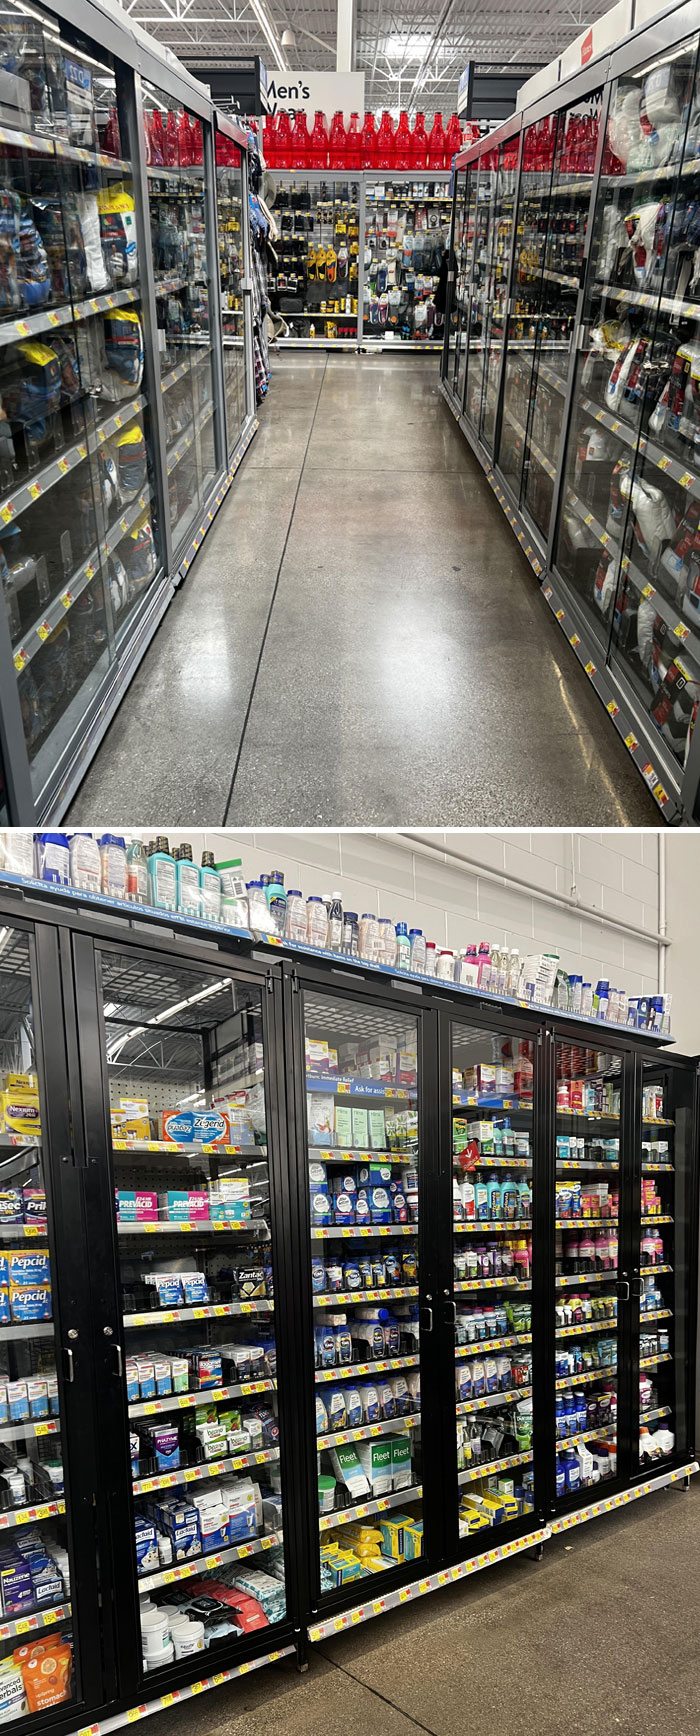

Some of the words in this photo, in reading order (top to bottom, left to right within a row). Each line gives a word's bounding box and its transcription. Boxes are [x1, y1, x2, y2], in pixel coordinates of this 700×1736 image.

[267, 80, 310, 99] Men's
[0, 1201, 20, 1210] sec
[27, 1202, 46, 1210] Pril
[11, 1255, 46, 1269] Pepcid
[239, 1271, 263, 1279] Zantac
[12, 1290, 46, 1304] Pepcid
[207, 1427, 224, 1435] beano
[231, 1436, 248, 1445] beano
[207, 1442, 224, 1450] beano
[373, 1452, 390, 1462] Fleet
[394, 1447, 409, 1457] Fleet
[340, 1452, 358, 1464] Fleet
[135, 1529, 154, 1541] actaid
[176, 1525, 197, 1538] Lactaid
[4, 1573, 30, 1584] Nauzene
[38, 1583, 60, 1594] Lactaid
